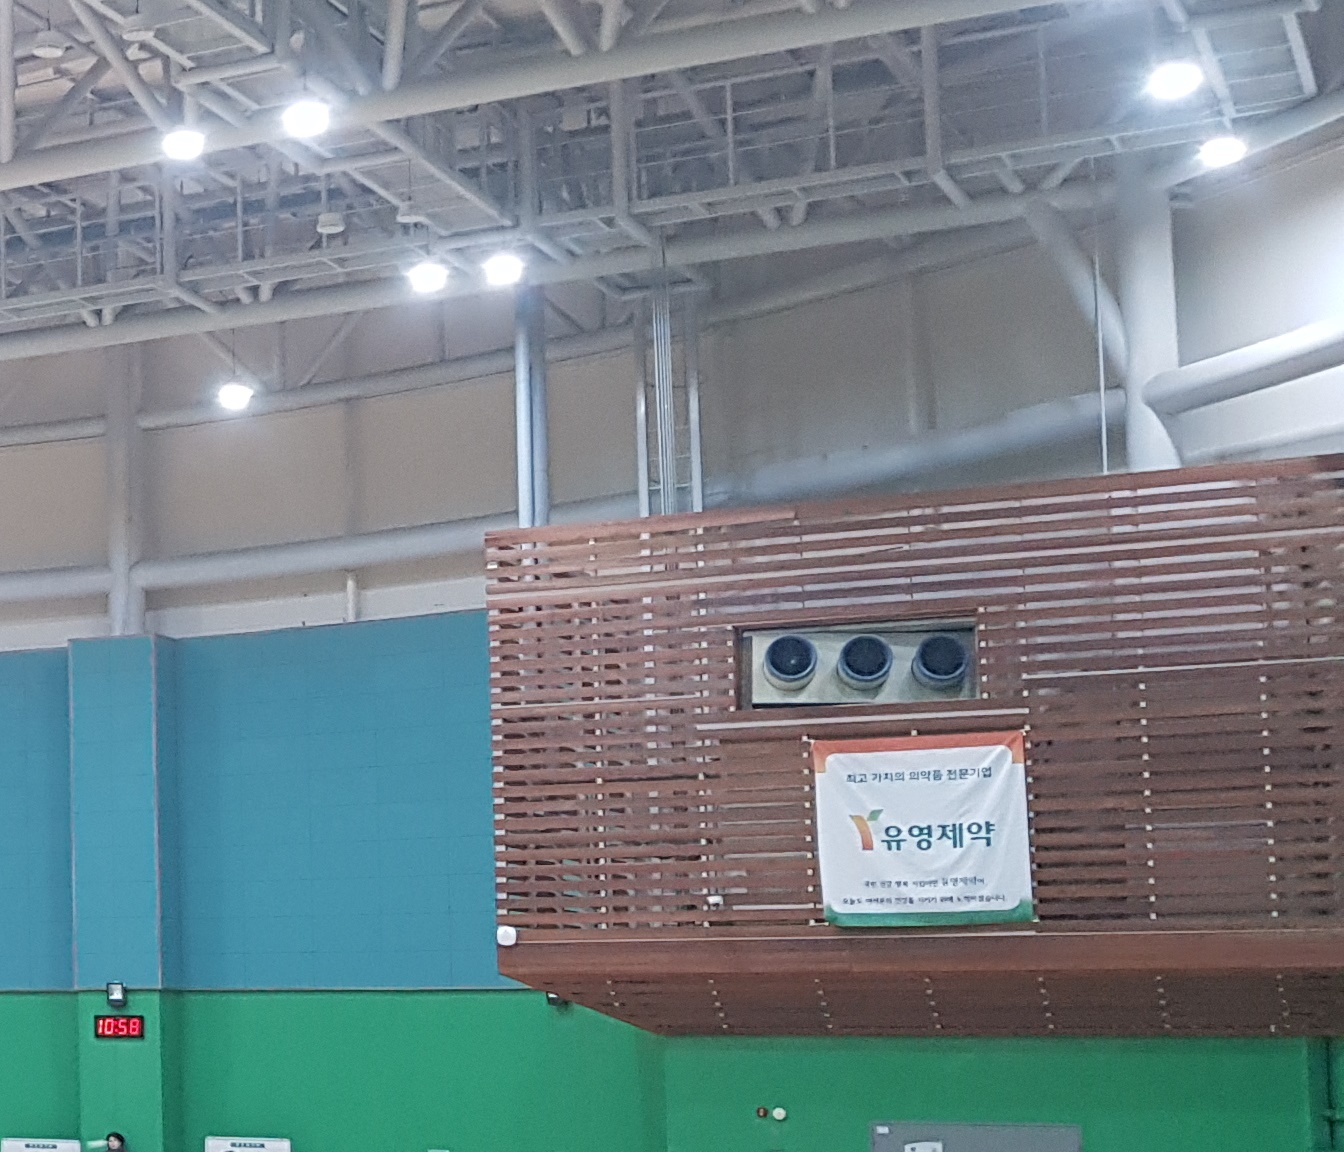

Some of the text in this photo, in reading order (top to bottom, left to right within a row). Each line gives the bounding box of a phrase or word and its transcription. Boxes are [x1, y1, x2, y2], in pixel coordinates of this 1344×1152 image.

[846, 766, 993, 784] 최고 가치의 의약품 전문기업
[881, 820, 996, 852] 유영제약
[97, 1018, 141, 1036] 10:58
